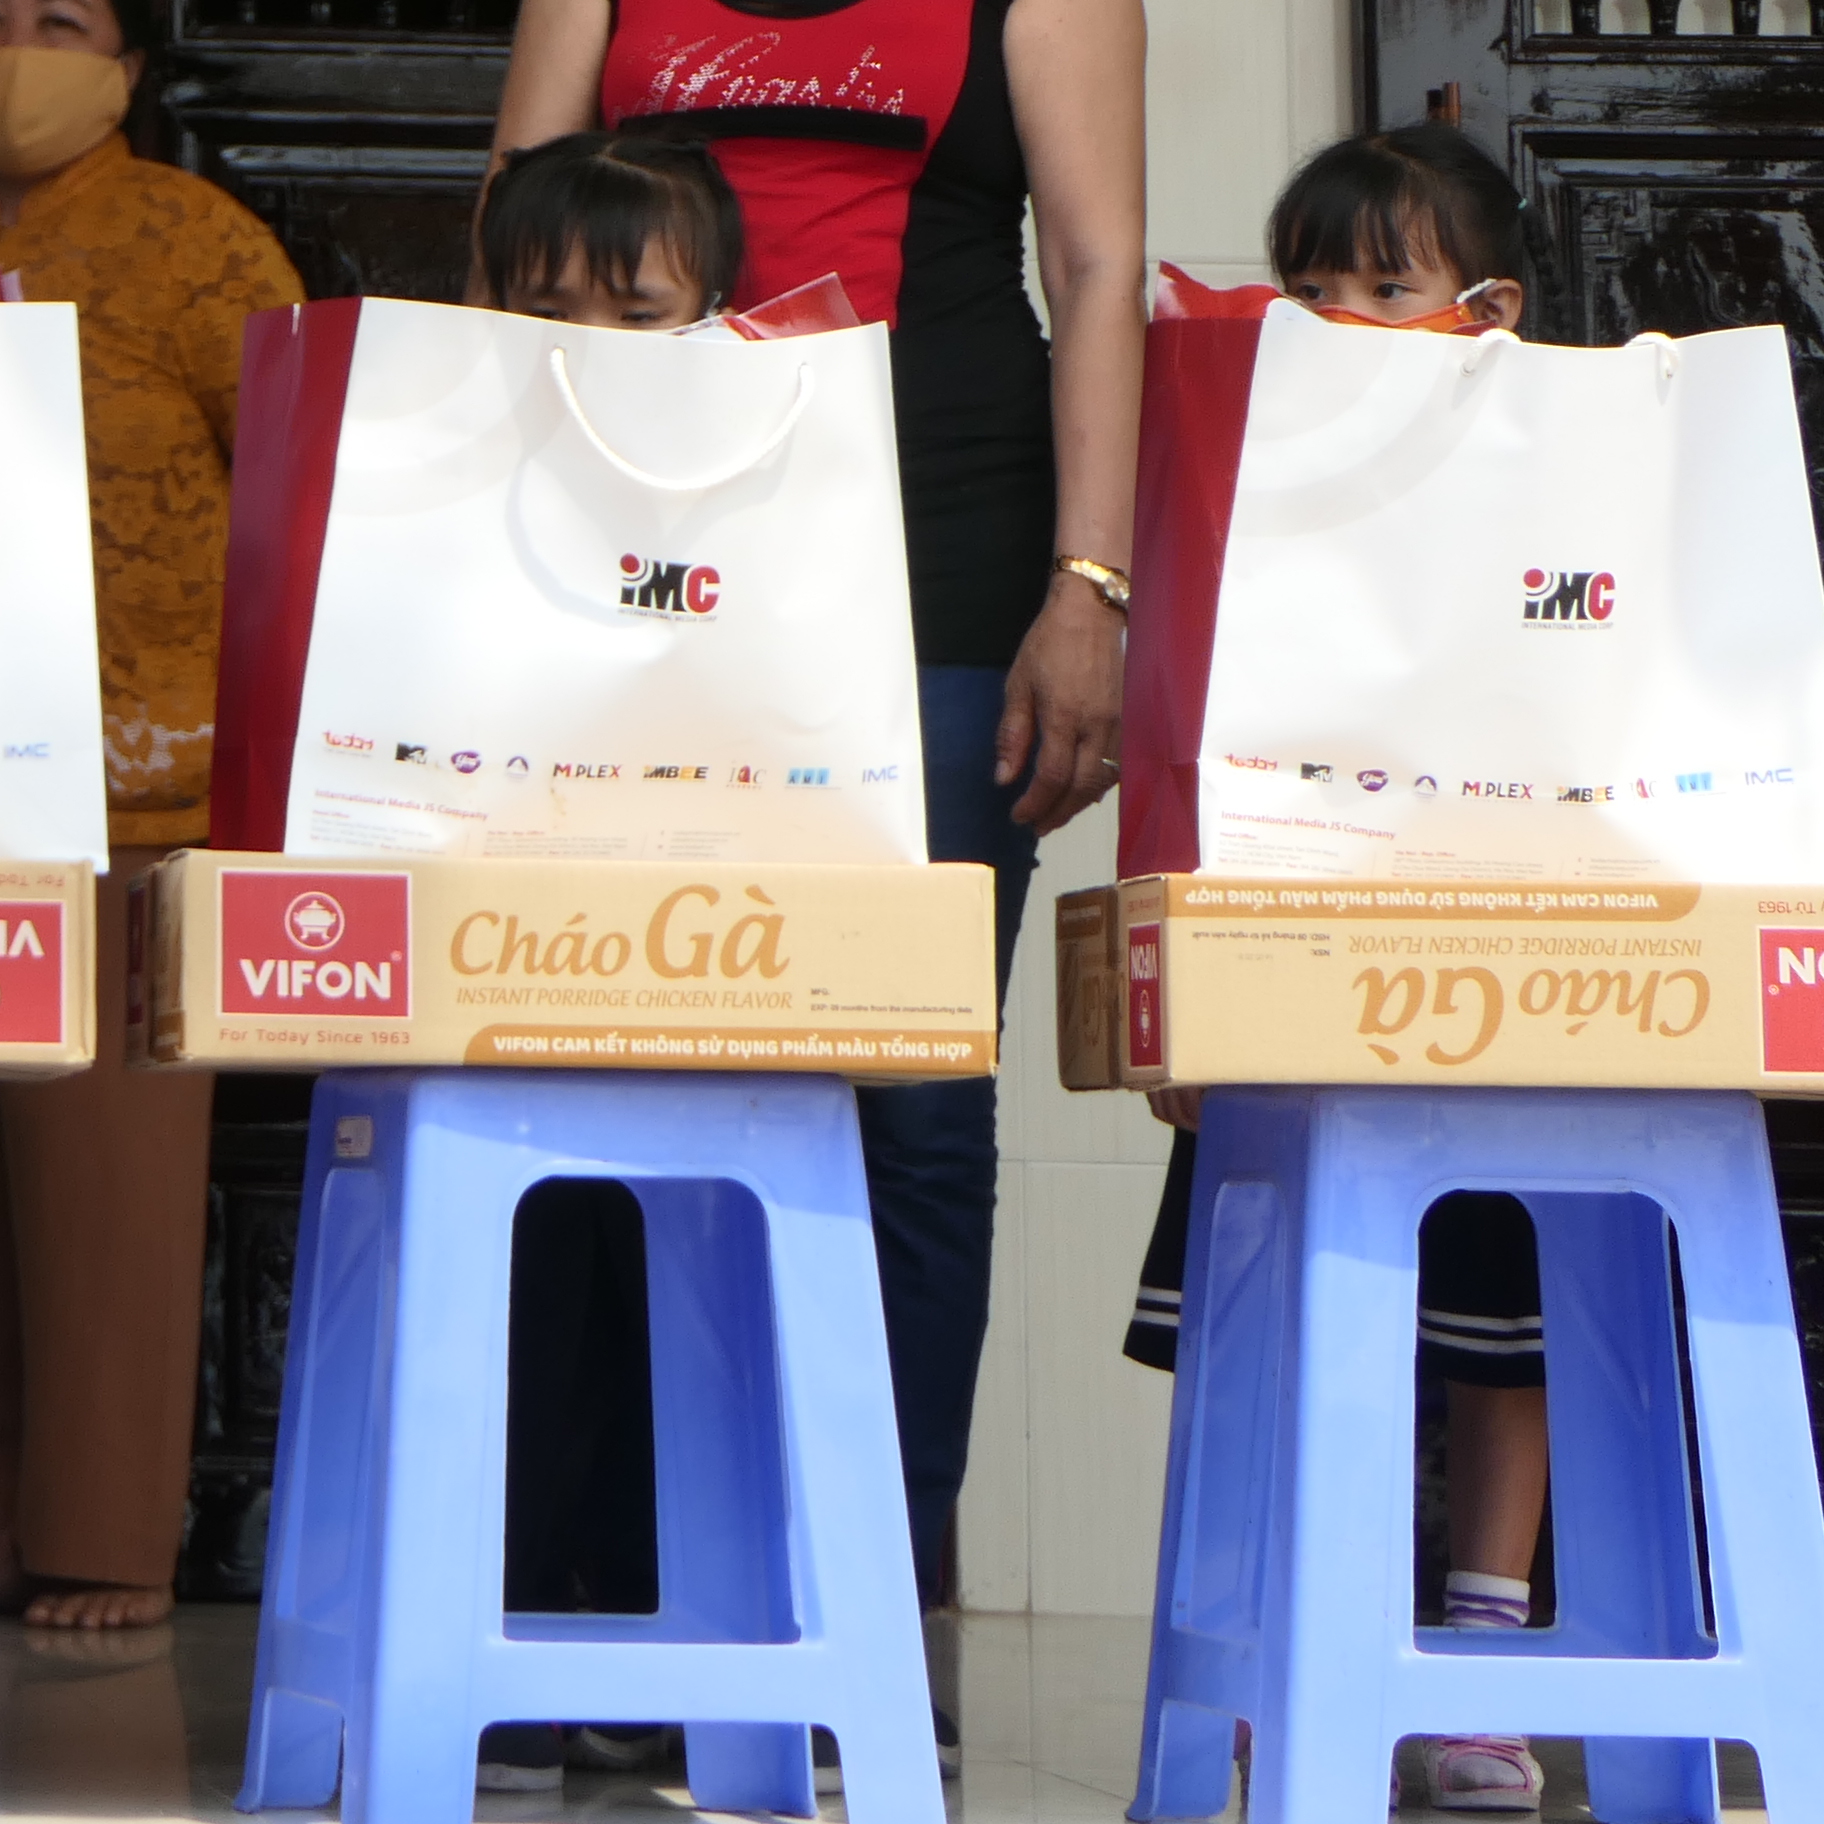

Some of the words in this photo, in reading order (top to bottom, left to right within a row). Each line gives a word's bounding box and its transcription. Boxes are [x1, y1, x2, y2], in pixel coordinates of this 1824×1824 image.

[1221, 811, 1291, 826] International
[1294, 817, 1326, 830] Media
[1344, 823, 1396, 840] Company
[1185, 886, 1224, 905] HỢP
[1227, 889, 1276, 911] TỔNG
[1321, 890, 1373, 912] PHẨM
[1376, 887, 1426, 906] DỤNG
[1458, 891, 1523, 911] KHÔNG
[1525, 892, 1558, 913] KẾT
[1561, 893, 1599, 908] CAM
[1602, 893, 1659, 908] VIFON
[1758, 901, 1792, 914] 1963
[449, 910, 631, 977] Cháo
[645, 883, 790, 979] Gà
[1348, 935, 1423, 954] FLAVOR
[1428, 936, 1513, 955] CHICKEN
[1518, 936, 1618, 956] PORRIDGE
[1620, 938, 1702, 956] INSTANT
[239, 959, 391, 999] VIFON
[457, 988, 539, 1006] INSTANT
[541, 988, 632, 1007] PORRIDGE
[635, 988, 714, 1008] CHICKEN
[722, 990, 793, 1009] FLAVOR
[1518, 969, 1711, 1038] Cháo
[1352, 966, 1504, 1066] Gà
[257, 1029, 308, 1045] Today
[318, 1030, 362, 1043] Since
[371, 1032, 410, 1045] 1963
[493, 1036, 549, 1052] VIFON
[551, 1037, 590, 1053] CAM
[631, 1033, 694, 1055] KHÔNG
